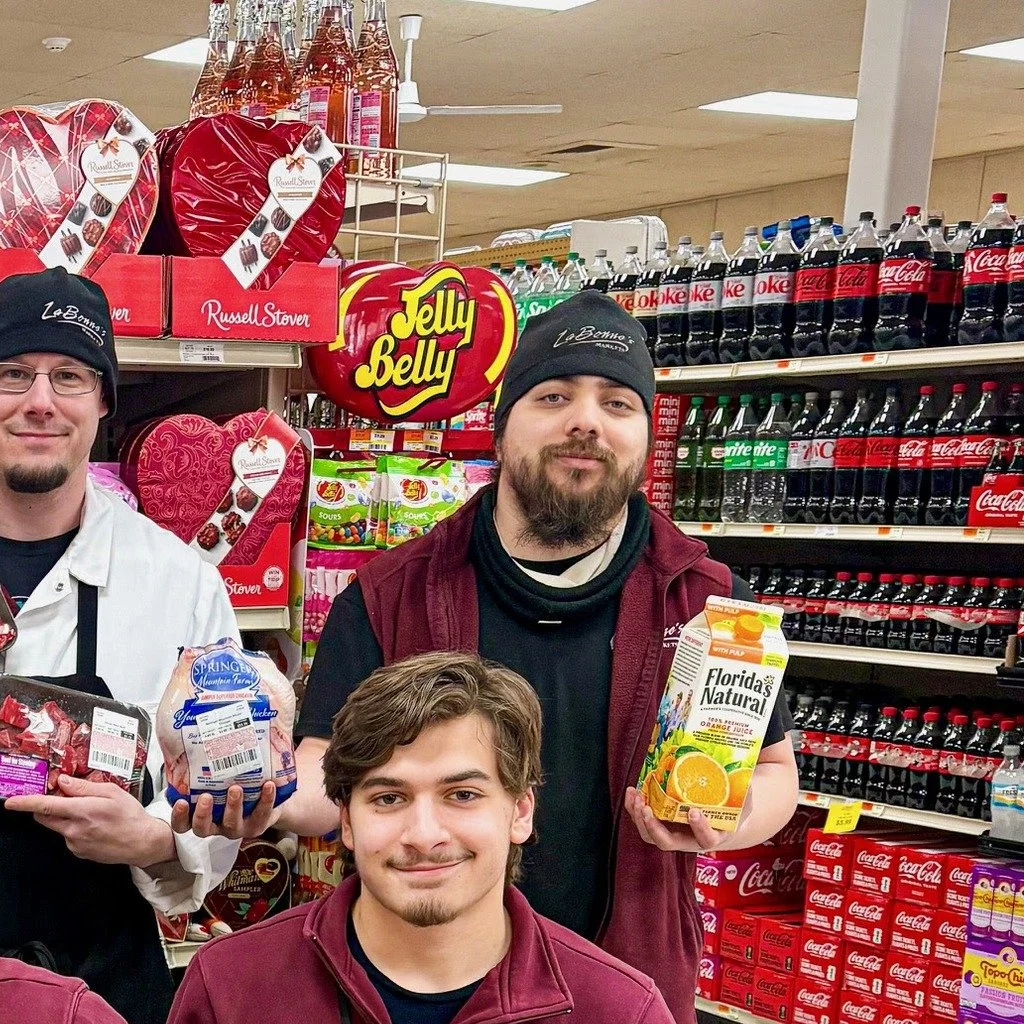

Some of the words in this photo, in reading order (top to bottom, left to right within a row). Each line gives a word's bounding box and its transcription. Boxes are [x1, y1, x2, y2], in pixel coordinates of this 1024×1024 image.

[275, 176, 296, 187] Russell
[296, 176, 317, 187] Stover
[201, 299, 259, 330] Russell
[262, 302, 311, 328] Stover
[391, 278, 476, 349] Jelly
[355, 335, 456, 398] Belly
[659, 396, 680, 406] mini
[659, 406, 679, 416] mini
[658, 416, 678, 426] mini
[725, 441, 752, 456] rite
[319, 511, 342, 520] SOURS
[226, 577, 262, 595] Stover
[706, 667, 774, 698] Florida's
[700, 687, 767, 716] Natural
[700, 721, 731, 731] ORANGE
[733, 727, 753, 735] JUICE
